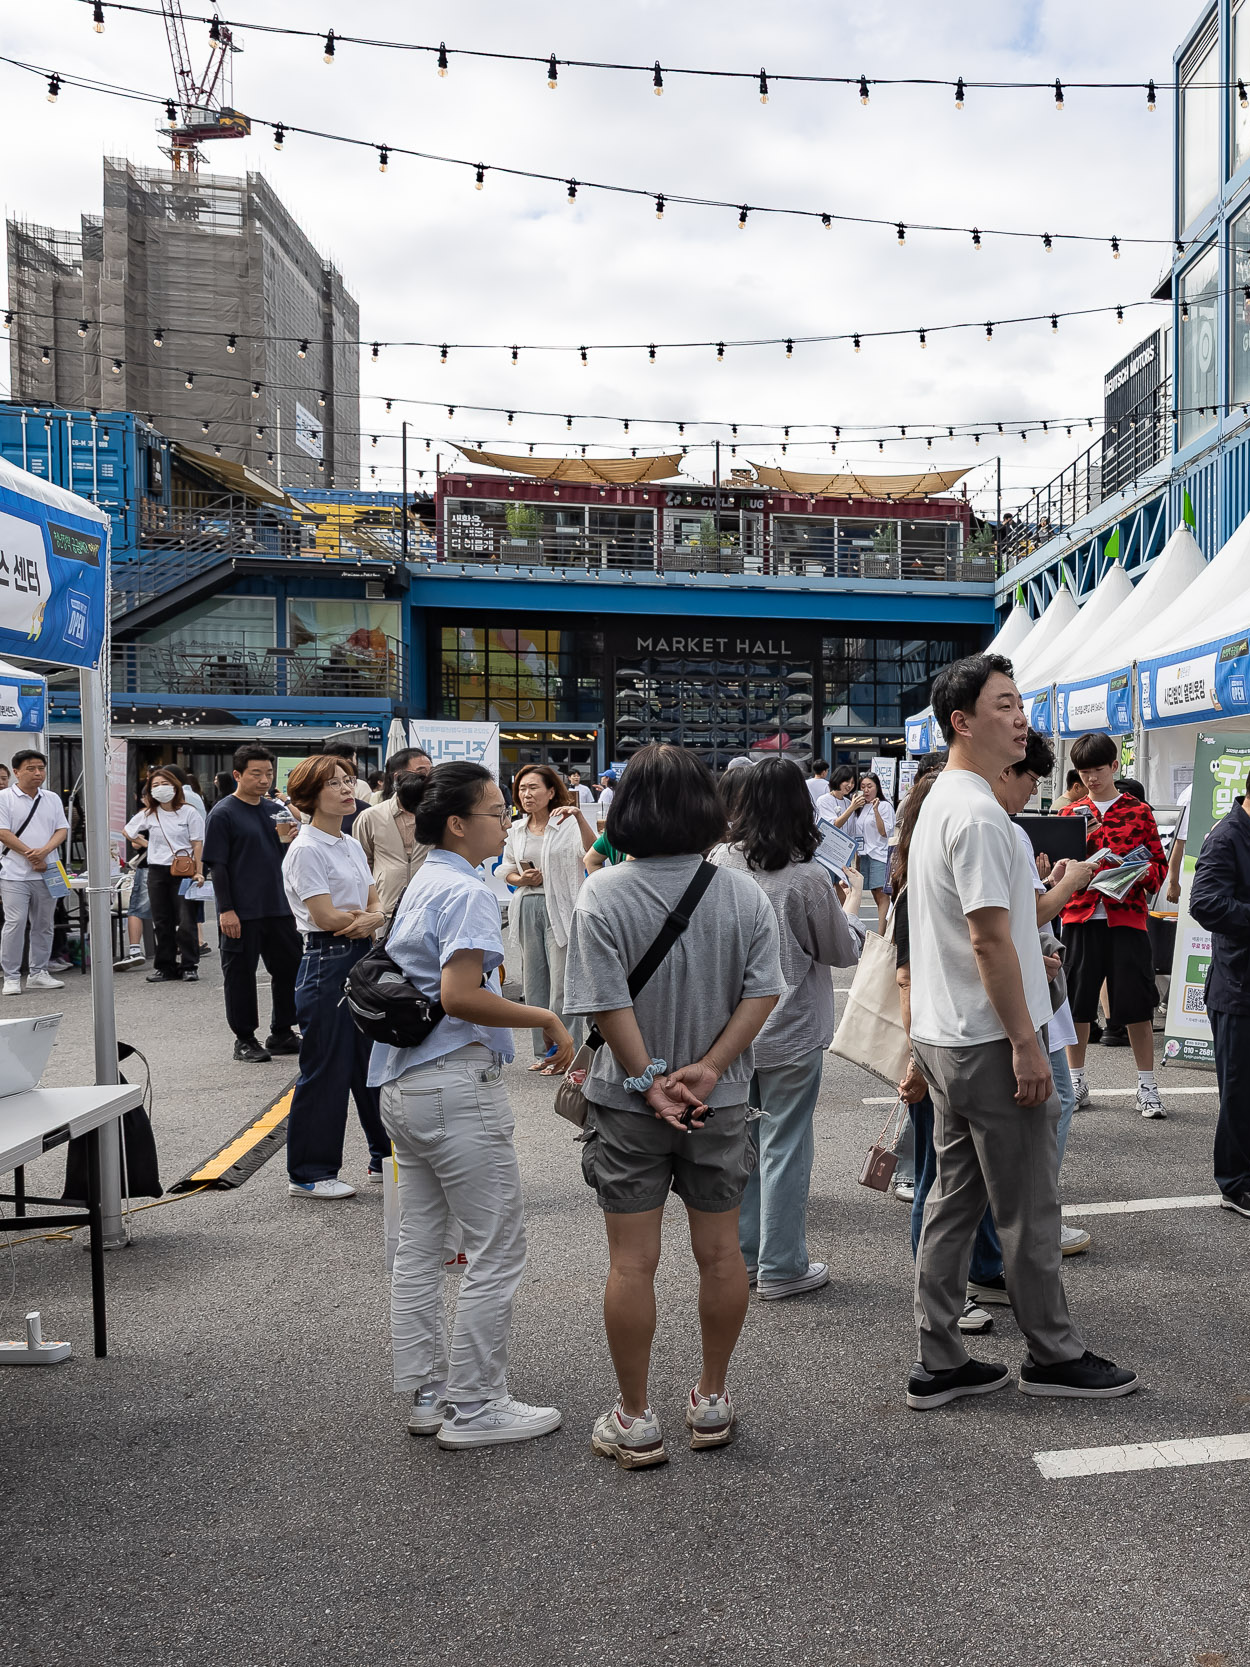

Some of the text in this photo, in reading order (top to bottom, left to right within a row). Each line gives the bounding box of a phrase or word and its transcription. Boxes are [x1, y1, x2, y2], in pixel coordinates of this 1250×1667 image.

[14, 554, 41, 597] 센터
[637, 637, 791, 655] MARKET HALL
